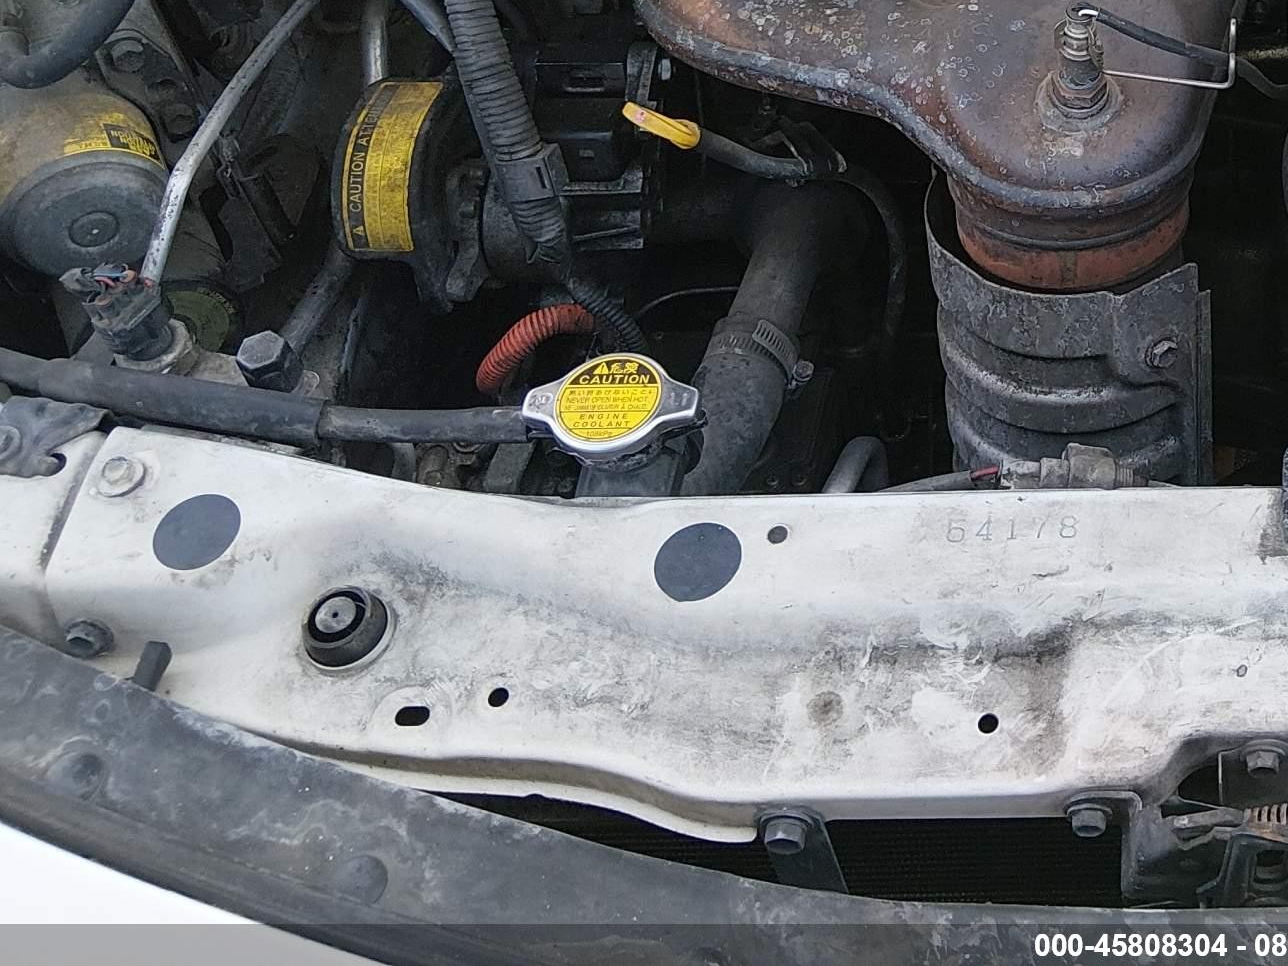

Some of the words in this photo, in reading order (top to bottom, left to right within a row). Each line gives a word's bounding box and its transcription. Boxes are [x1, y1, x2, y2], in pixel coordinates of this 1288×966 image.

[350, 152, 366, 212] CAUTION
[579, 374, 651, 385] CAUTION
[566, 396, 591, 404] NEVER
